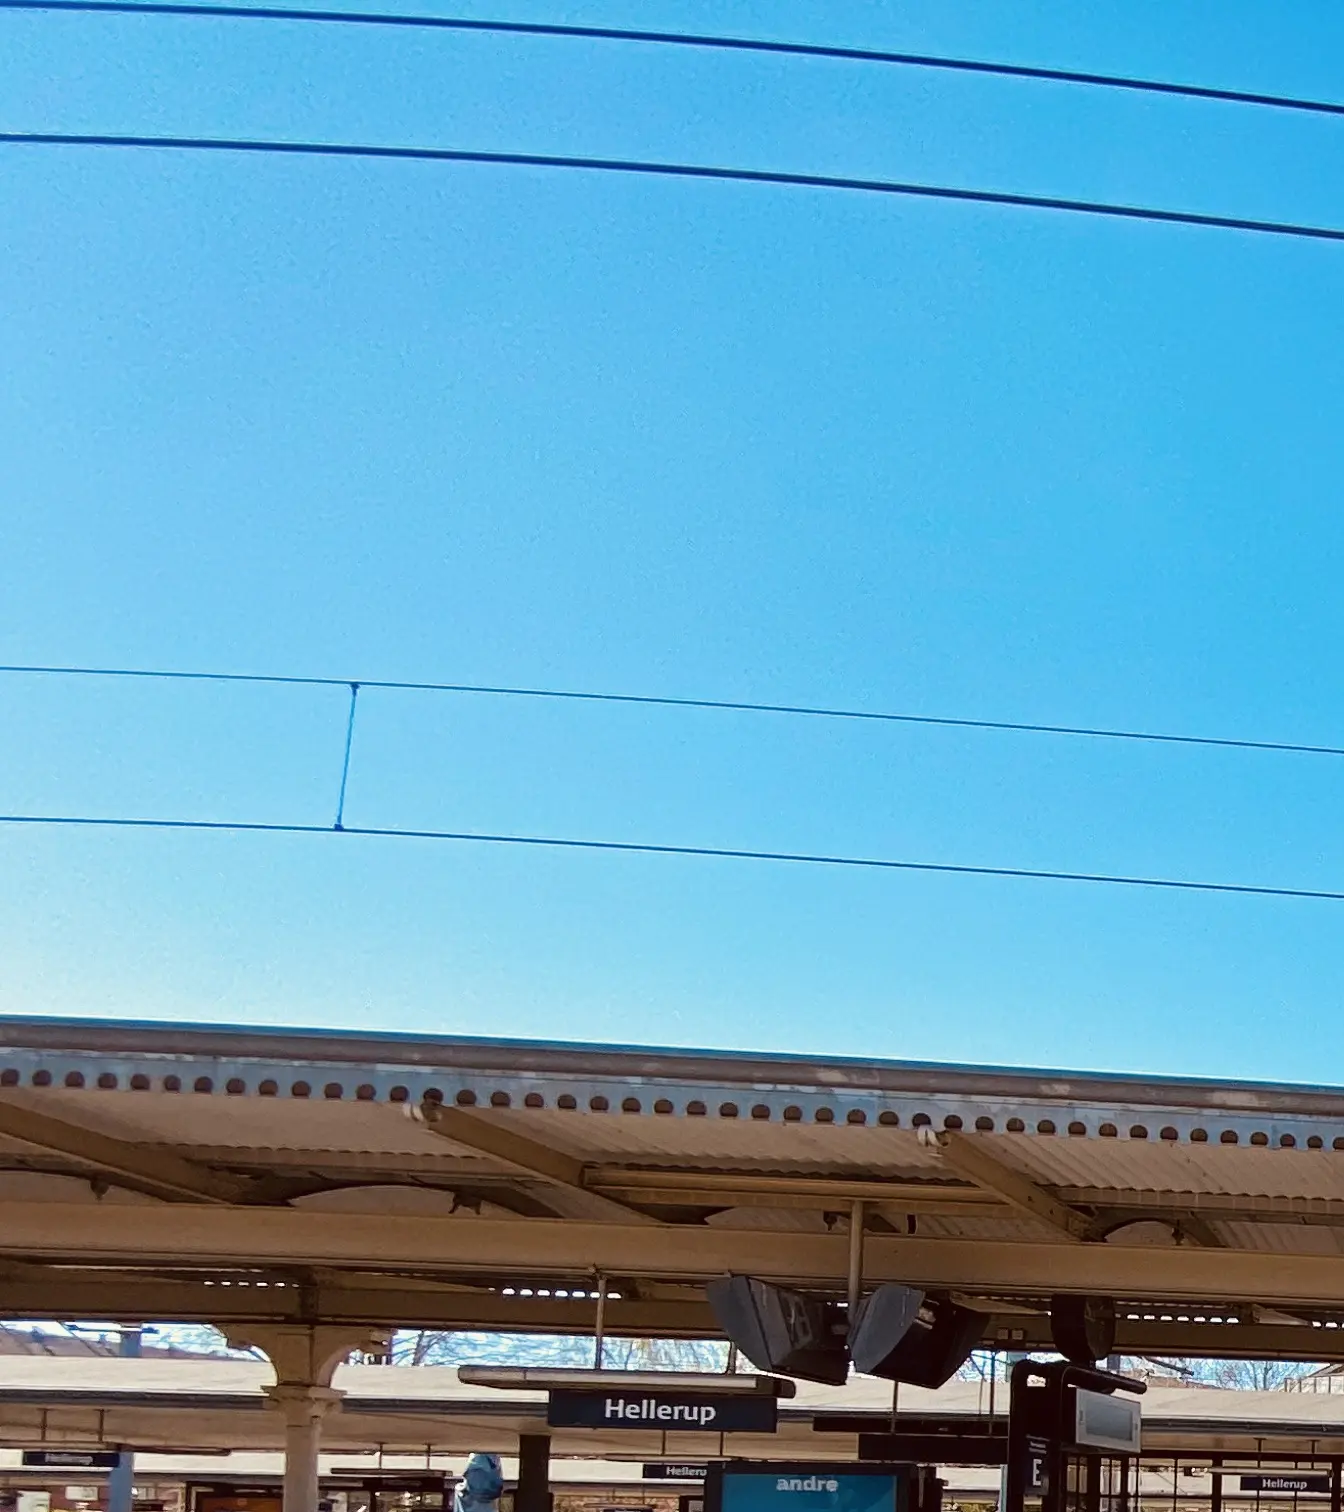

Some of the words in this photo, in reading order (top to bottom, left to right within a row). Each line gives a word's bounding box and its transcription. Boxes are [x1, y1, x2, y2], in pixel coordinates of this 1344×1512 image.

[605, 1398, 717, 1426] Hellerup
[666, 1466, 708, 1477] Helleru
[1032, 1458, 1043, 1486] E
[776, 1475, 839, 1492] andre
[1262, 1478, 1308, 1490] Hellerup
